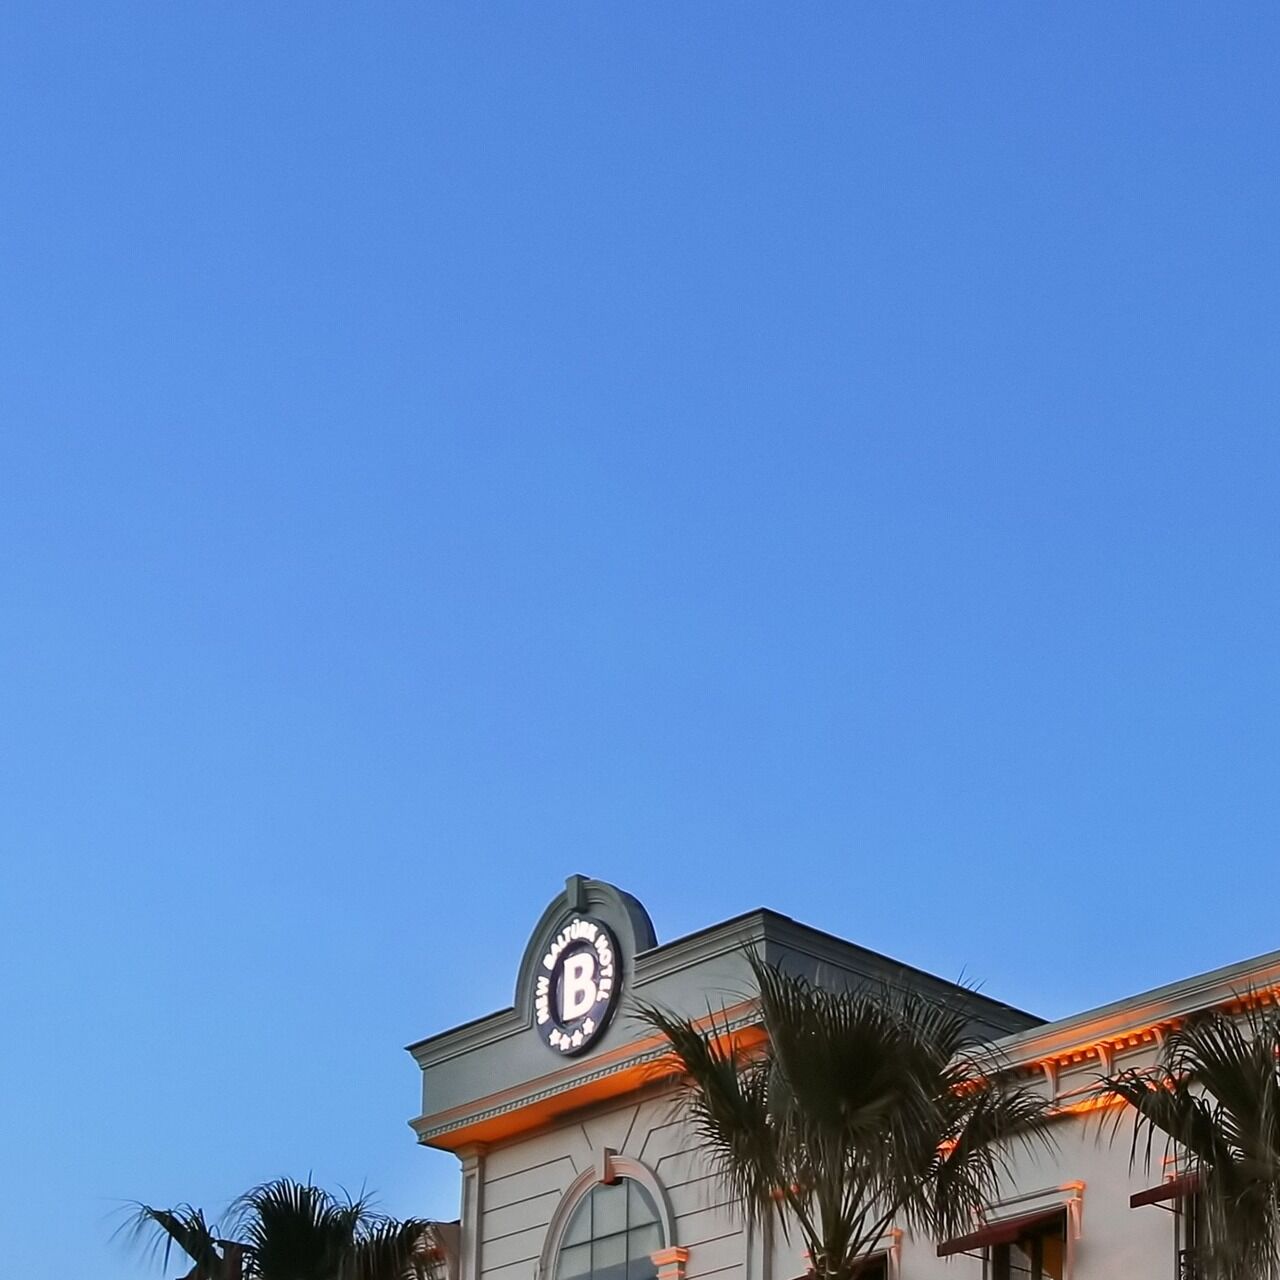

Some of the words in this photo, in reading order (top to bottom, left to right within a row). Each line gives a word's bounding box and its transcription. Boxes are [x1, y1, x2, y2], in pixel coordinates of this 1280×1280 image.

[536, 976, 549, 1024] NEW
[594, 934, 613, 1001] HOTEL
[562, 953, 597, 1022] B
